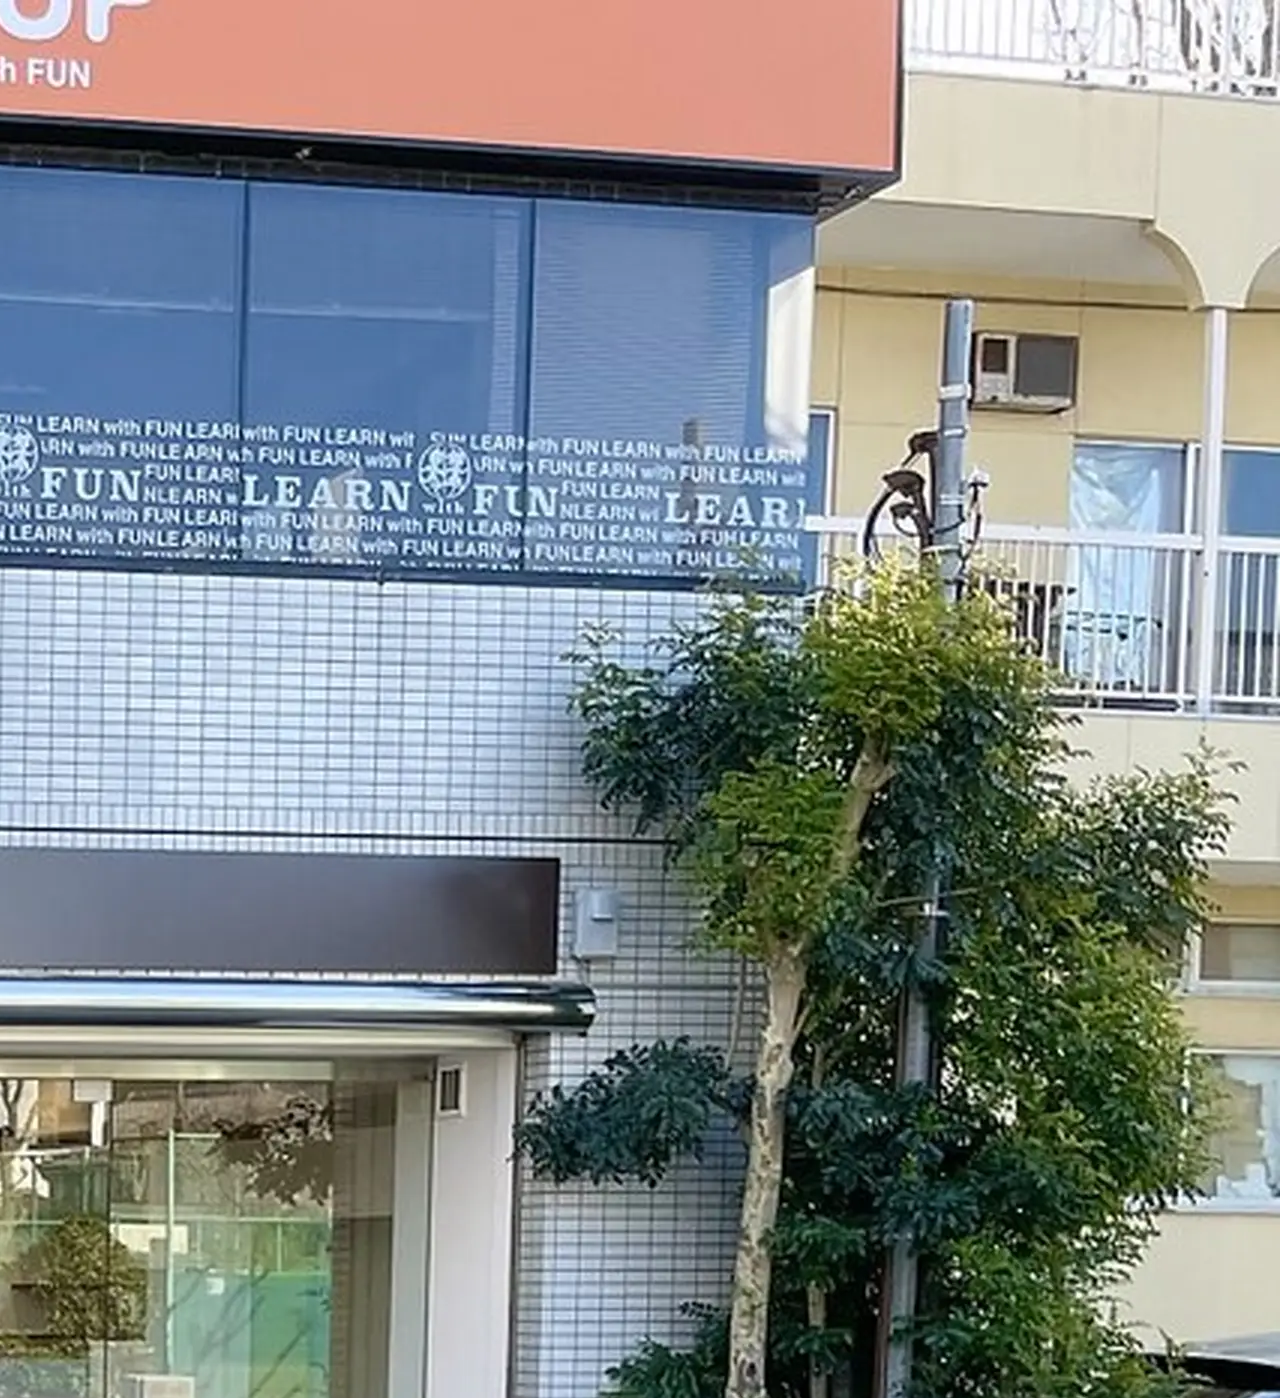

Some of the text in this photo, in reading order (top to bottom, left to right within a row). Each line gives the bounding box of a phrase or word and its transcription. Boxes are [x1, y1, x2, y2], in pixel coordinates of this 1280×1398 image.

[28, 58, 92, 88] FUN
[38, 416, 182, 437] LEARN with FUN
[243, 425, 385, 446] with FUN LEARN
[120, 441, 222, 462] FUN LEARN
[300, 449, 360, 467] LEARN
[562, 438, 738, 462] FUN LEARN FUN
[144, 464, 180, 480] FUN
[538, 459, 776, 486] FUN LEARN FUN LEARN
[41, 466, 140, 501] FUN
[242, 474, 412, 512] LEARN
[561, 481, 659, 500] FUN LEARN
[159, 488, 221, 504] LEARN
[36, 503, 179, 523] LEARN FUN
[10, 524, 72, 541] LEARN
[118, 529, 153, 545] FUN
[158, 530, 220, 547] LEARN
[387, 518, 463, 535] with FUN
[560, 523, 595, 540] FUN
[404, 539, 502, 558] FUN LEARN
